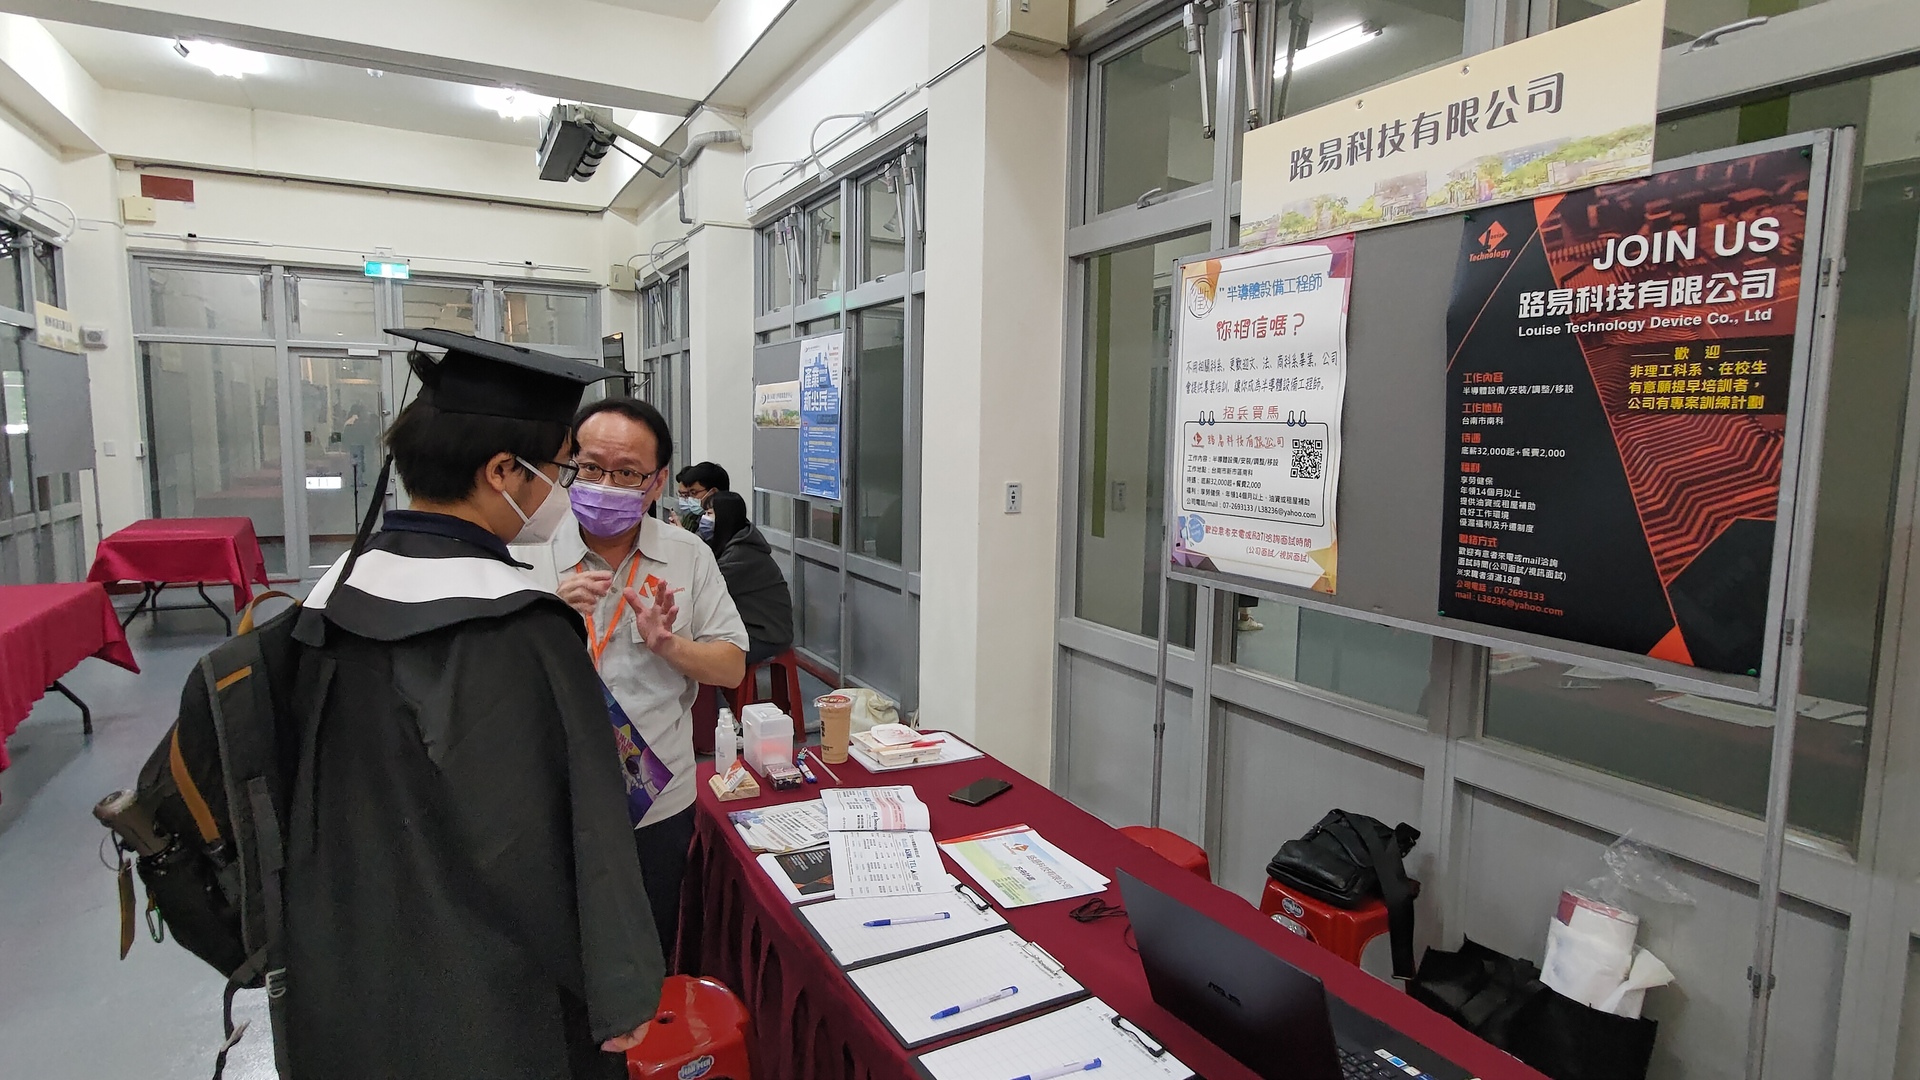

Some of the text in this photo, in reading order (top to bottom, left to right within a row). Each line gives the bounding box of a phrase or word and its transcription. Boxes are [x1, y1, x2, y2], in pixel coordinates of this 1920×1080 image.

[1288, 72, 1565, 183] 路易科技有限公司
[1593, 216, 1780, 271] JOIN US
[1469, 250, 1511, 262] Technology
[1517, 268, 1777, 319] 路易科技有限公司
[1518, 308, 1772, 337] Louise Technology Device Co., Ltd
[1462, 372, 1504, 384] 工作內容
[1462, 403, 1503, 414] 工作地點
[1628, 395, 1765, 410] 公司有專案訓練計劃
[1222, 405, 1279, 420] 招兵買馬
[1462, 416, 1504, 425] 台南市南科
[1460, 486, 1521, 499] 年領14個月以上
